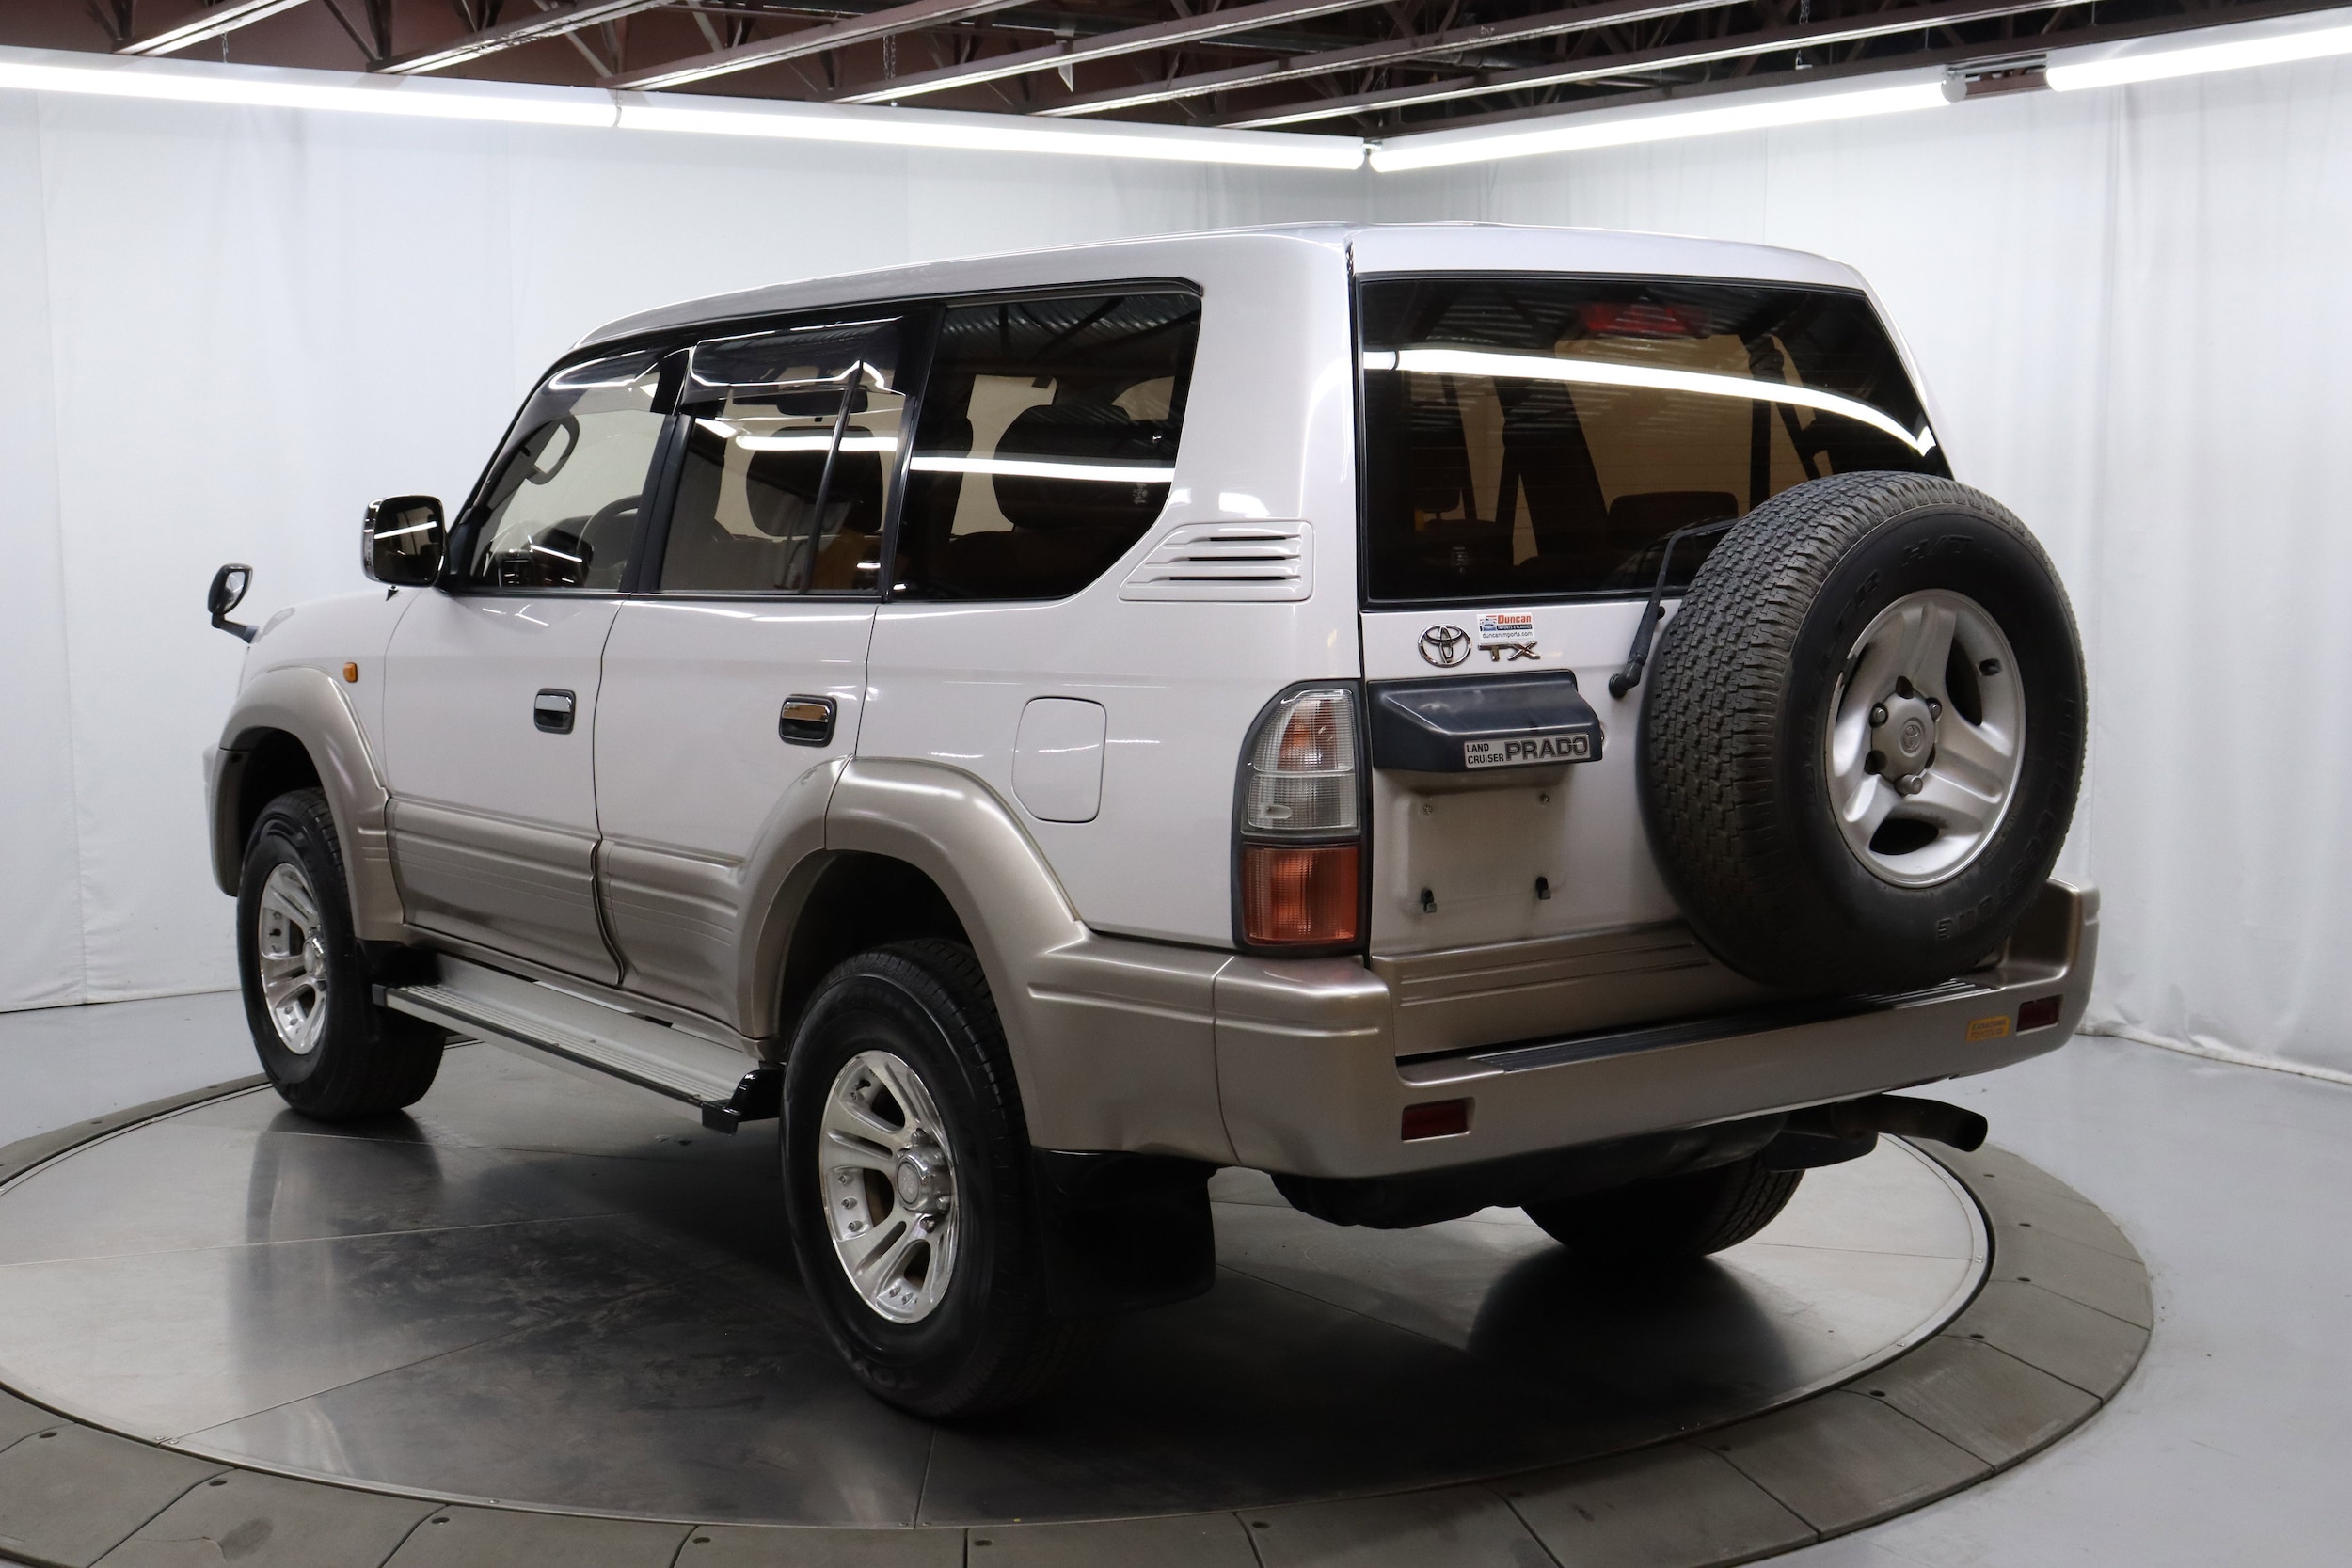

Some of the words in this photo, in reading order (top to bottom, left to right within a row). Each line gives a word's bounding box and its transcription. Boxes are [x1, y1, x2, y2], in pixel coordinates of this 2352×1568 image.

[1497, 614, 1532, 625] Duncan
[1477, 641, 1541, 661] TX
[1466, 742, 1489, 752] LAND
[1467, 753, 1504, 765] CRUISER
[1504, 736, 1588, 762] PRADO
